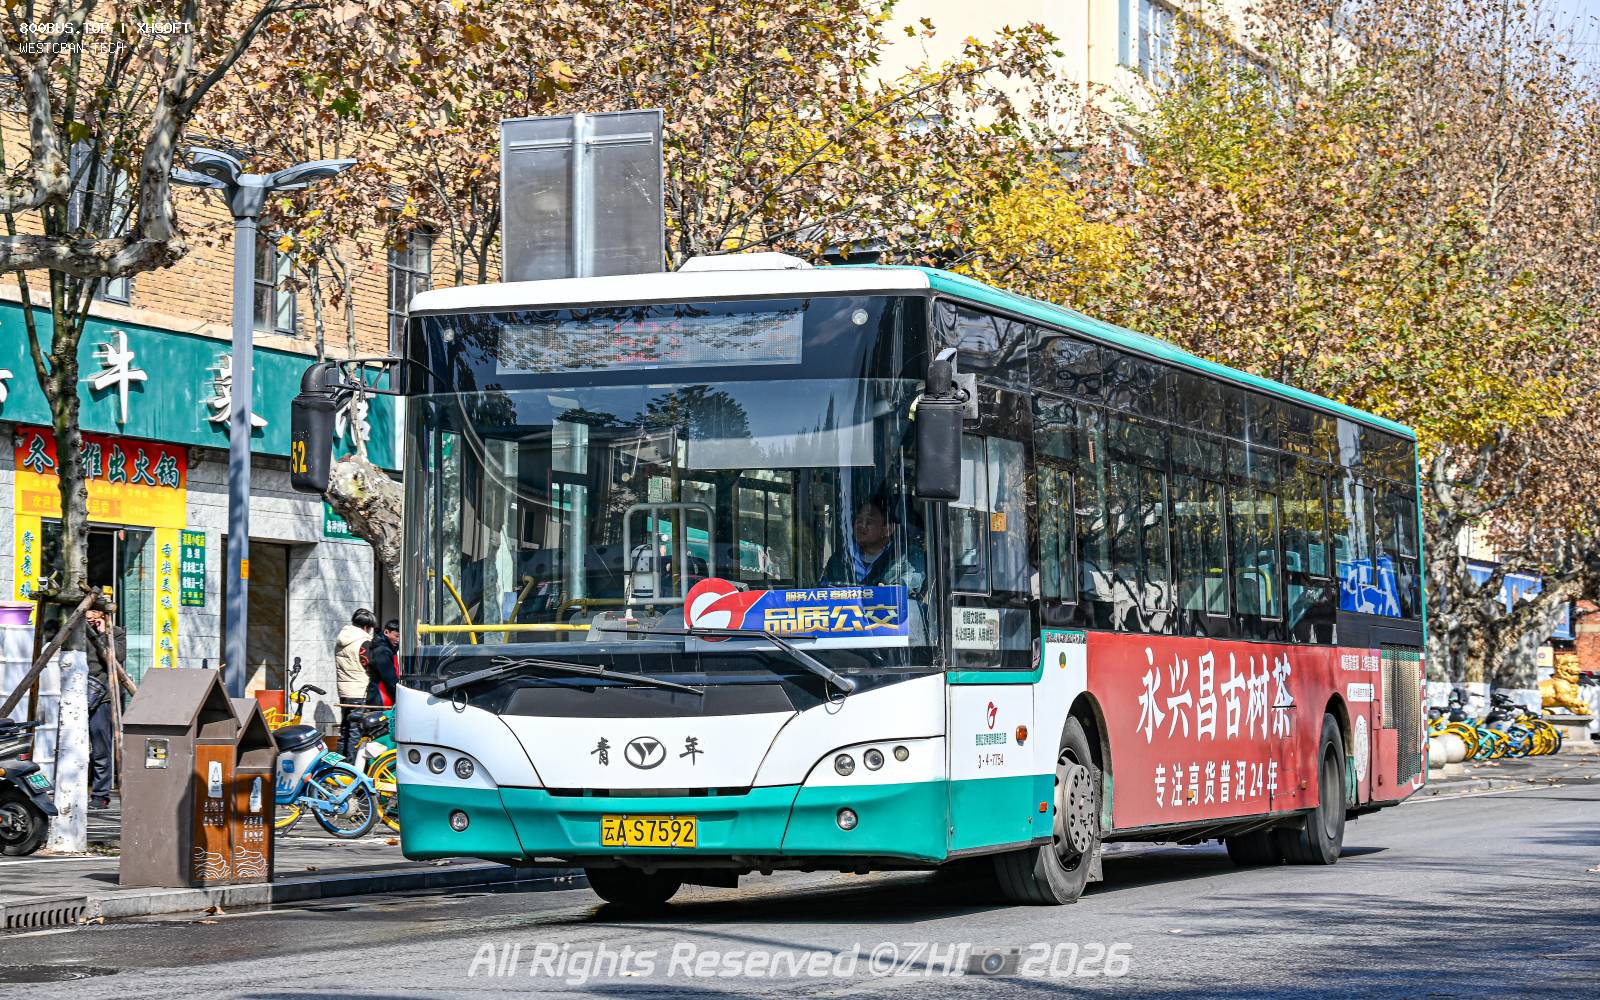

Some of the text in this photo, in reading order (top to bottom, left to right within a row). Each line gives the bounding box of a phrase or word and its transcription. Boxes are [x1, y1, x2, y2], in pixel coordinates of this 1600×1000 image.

[23, 433, 180, 489] 冬推出火锅
[291, 440, 307, 475] 52
[785, 589, 874, 602] 服务人民 奉献社会
[763, 604, 899, 634] 品质公交
[1136, 647, 1295, 745] 永兴昌古树茶
[590, 735, 705, 767] 青年
[1154, 757, 1278, 809] 专注高货普洱24年
